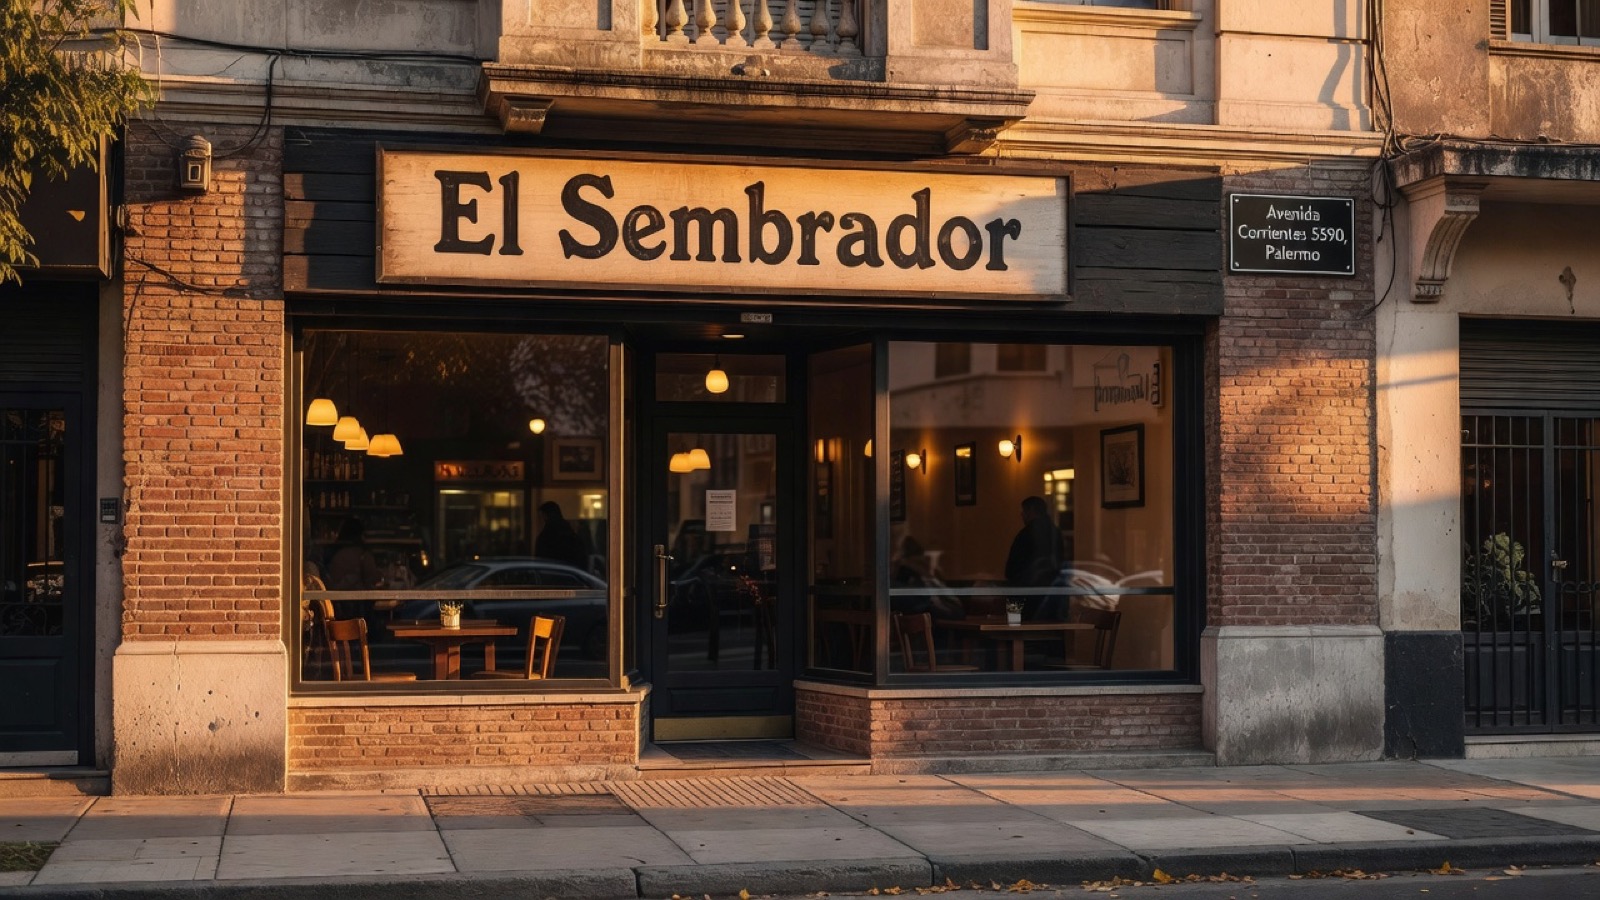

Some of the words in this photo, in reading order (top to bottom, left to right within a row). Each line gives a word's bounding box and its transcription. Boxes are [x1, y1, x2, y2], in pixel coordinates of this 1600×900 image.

[434, 170, 524, 256] El
[558, 173, 1022, 271] Sembrador
[1265, 204, 1321, 221] Avenida
[1238, 224, 1307, 241] Corrientes
[1310, 226, 1348, 245] 5590,
[1265, 244, 1321, 261] Palermo
